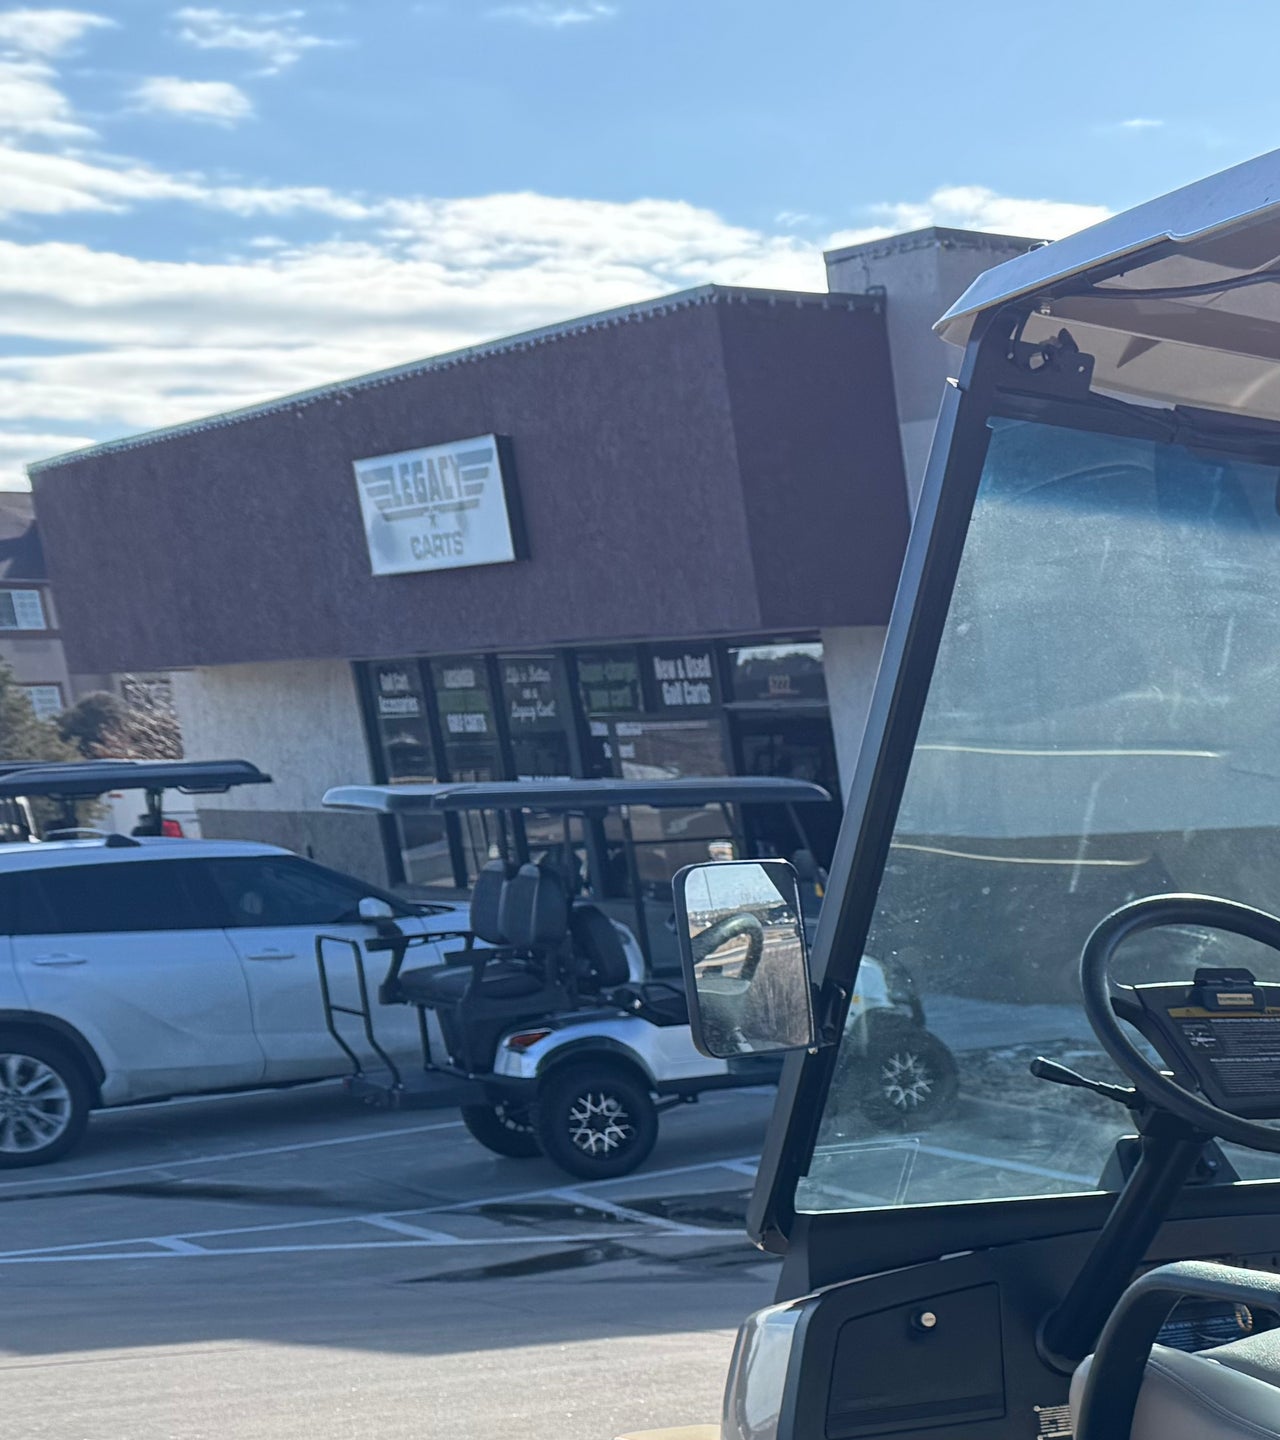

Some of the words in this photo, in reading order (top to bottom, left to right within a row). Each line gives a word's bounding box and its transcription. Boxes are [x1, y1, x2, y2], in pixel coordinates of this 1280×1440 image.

[390, 454, 464, 508] LEGACY
[410, 532, 464, 560] CARTS
[653, 656, 677, 681] New
[684, 653, 712, 679] Used
[662, 680, 684, 706] Golf
[683, 679, 712, 705] Carts
